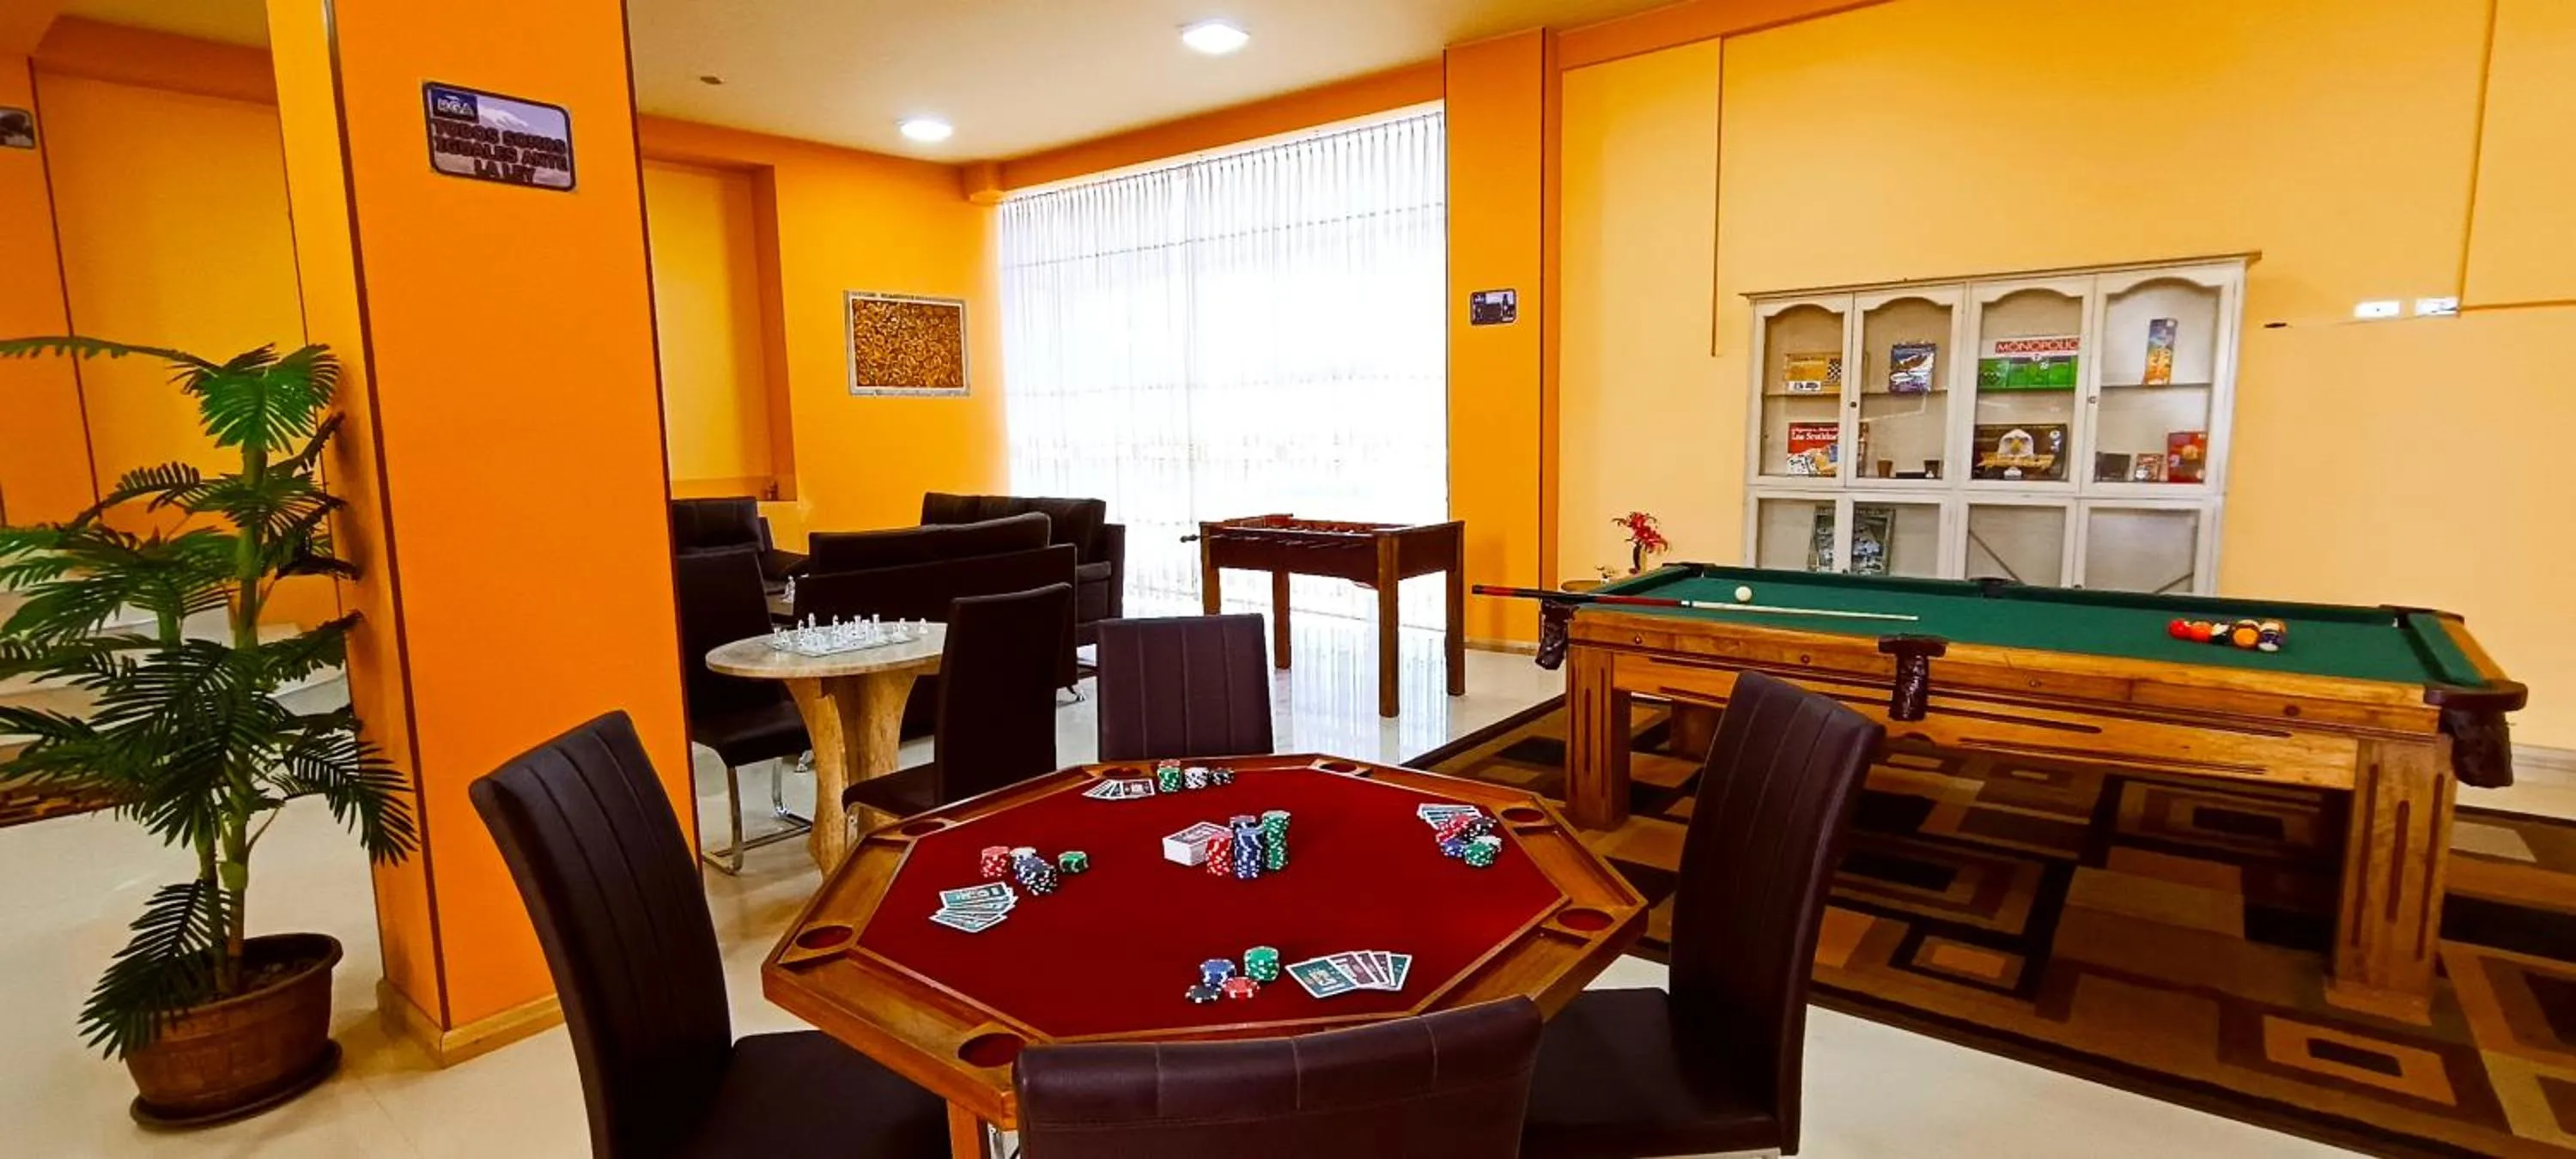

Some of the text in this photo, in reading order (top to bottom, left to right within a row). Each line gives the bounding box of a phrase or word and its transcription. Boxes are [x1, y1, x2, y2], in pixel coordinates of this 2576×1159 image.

[434, 136, 569, 172] IGUALES ANTE
[474, 159, 501, 179] LA
